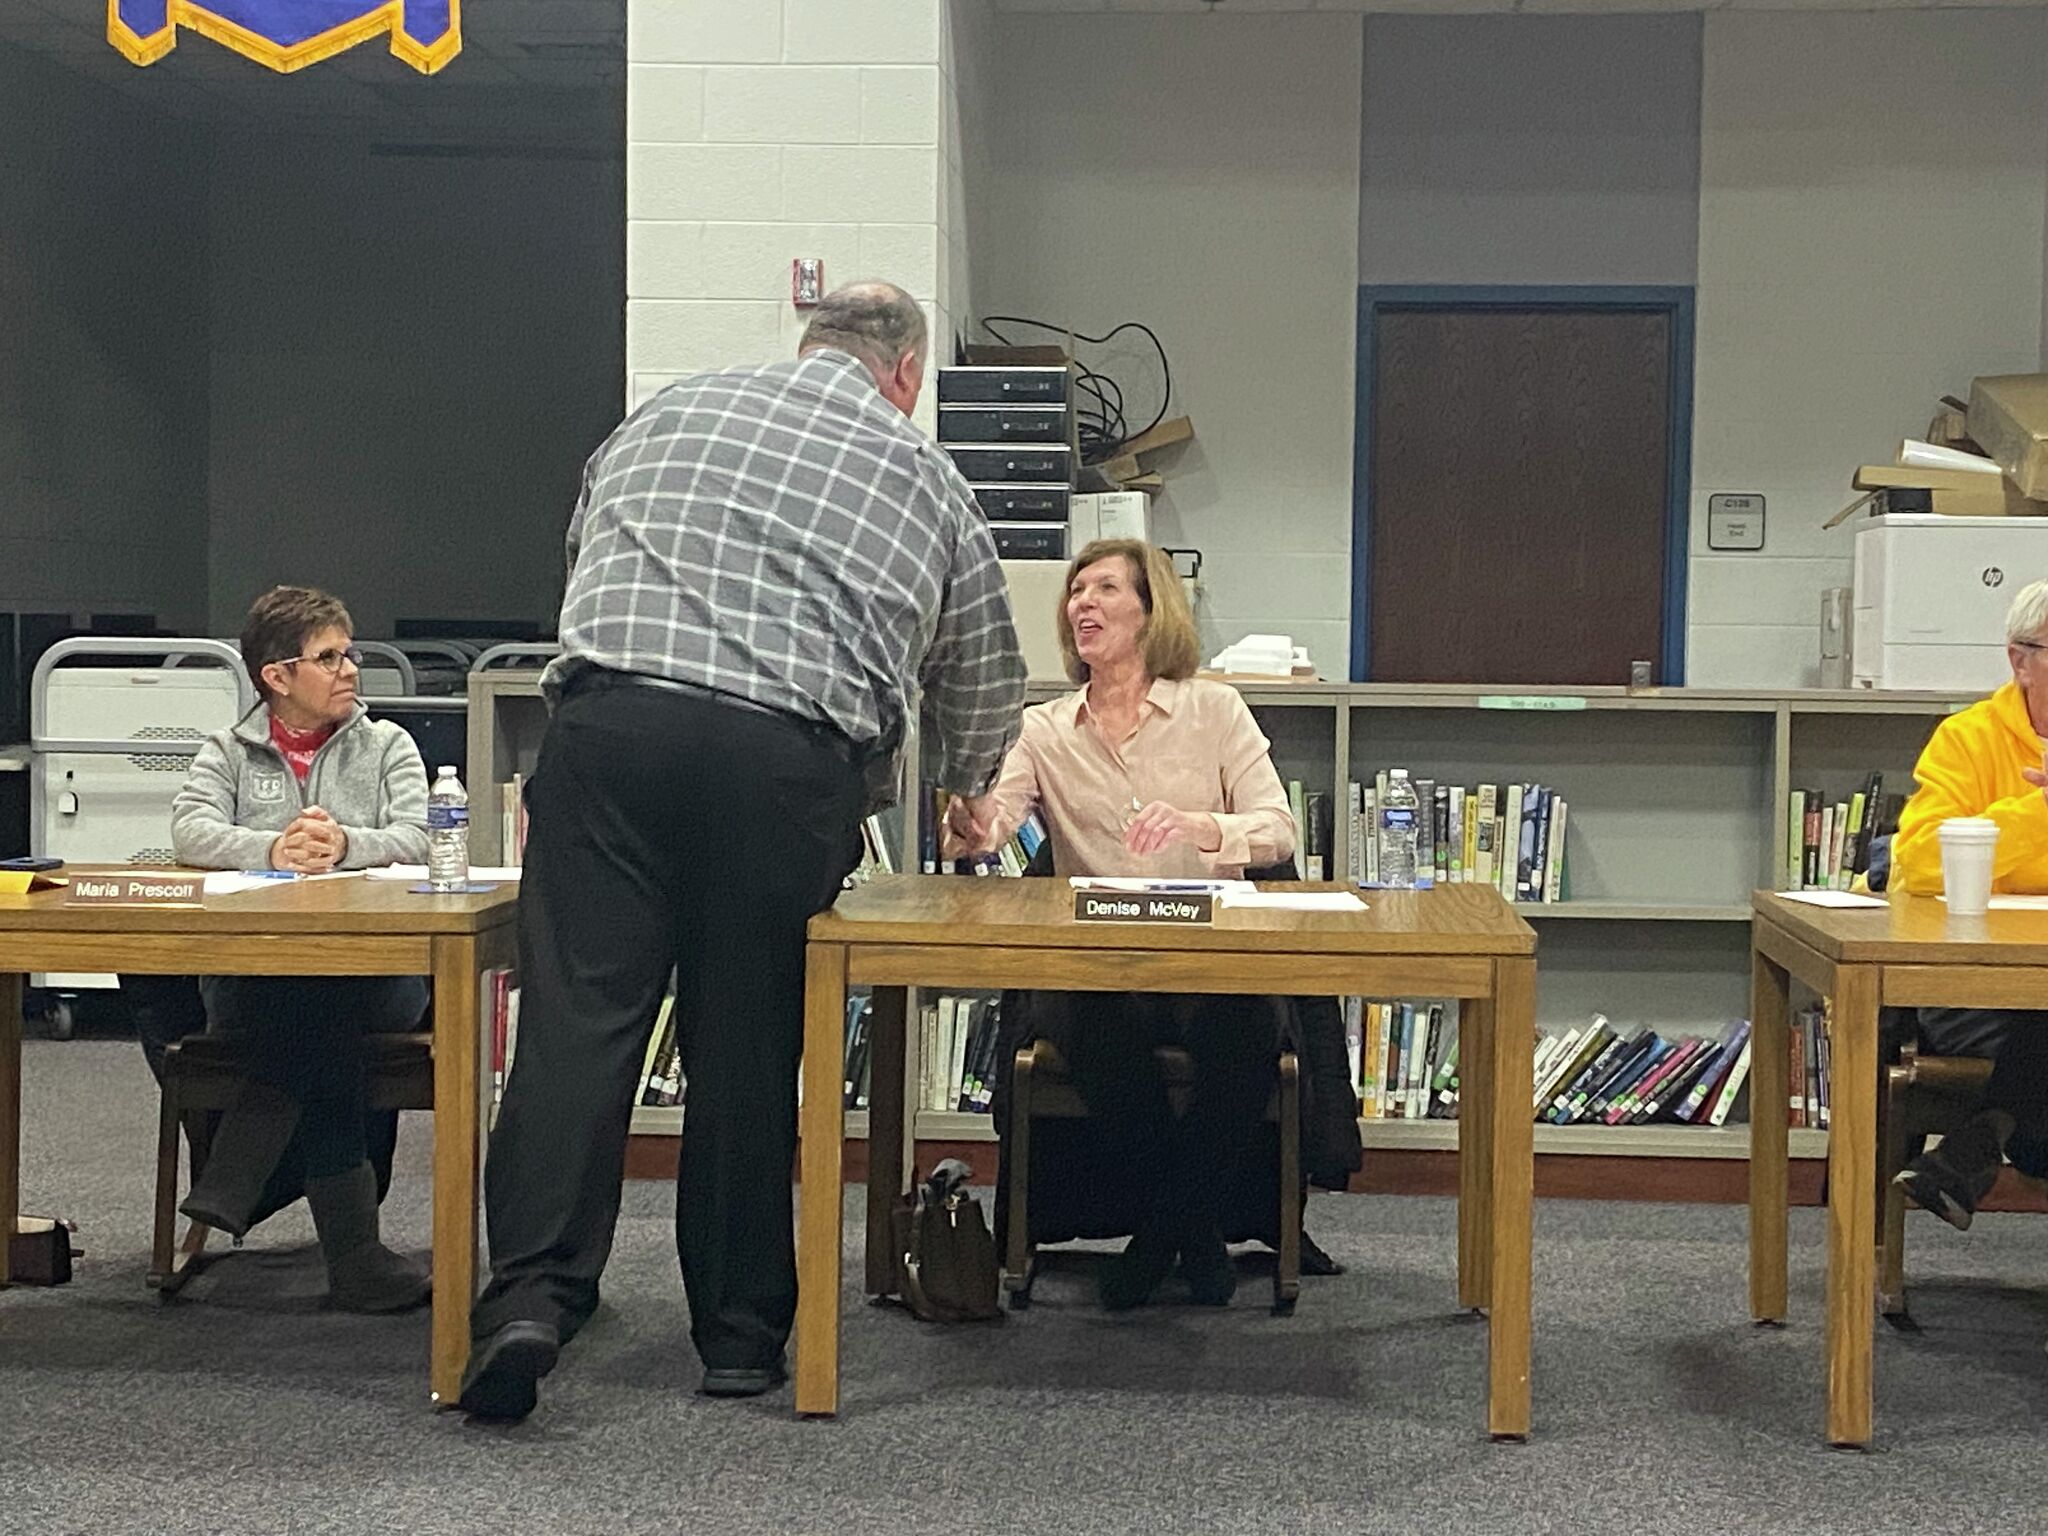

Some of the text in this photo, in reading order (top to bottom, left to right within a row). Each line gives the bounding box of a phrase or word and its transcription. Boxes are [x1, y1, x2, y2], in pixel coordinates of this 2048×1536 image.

[1983, 566, 2003, 588] hp
[75, 882, 195, 898] Maria Prescott
[1086, 900, 1200, 920] Denise McVey
